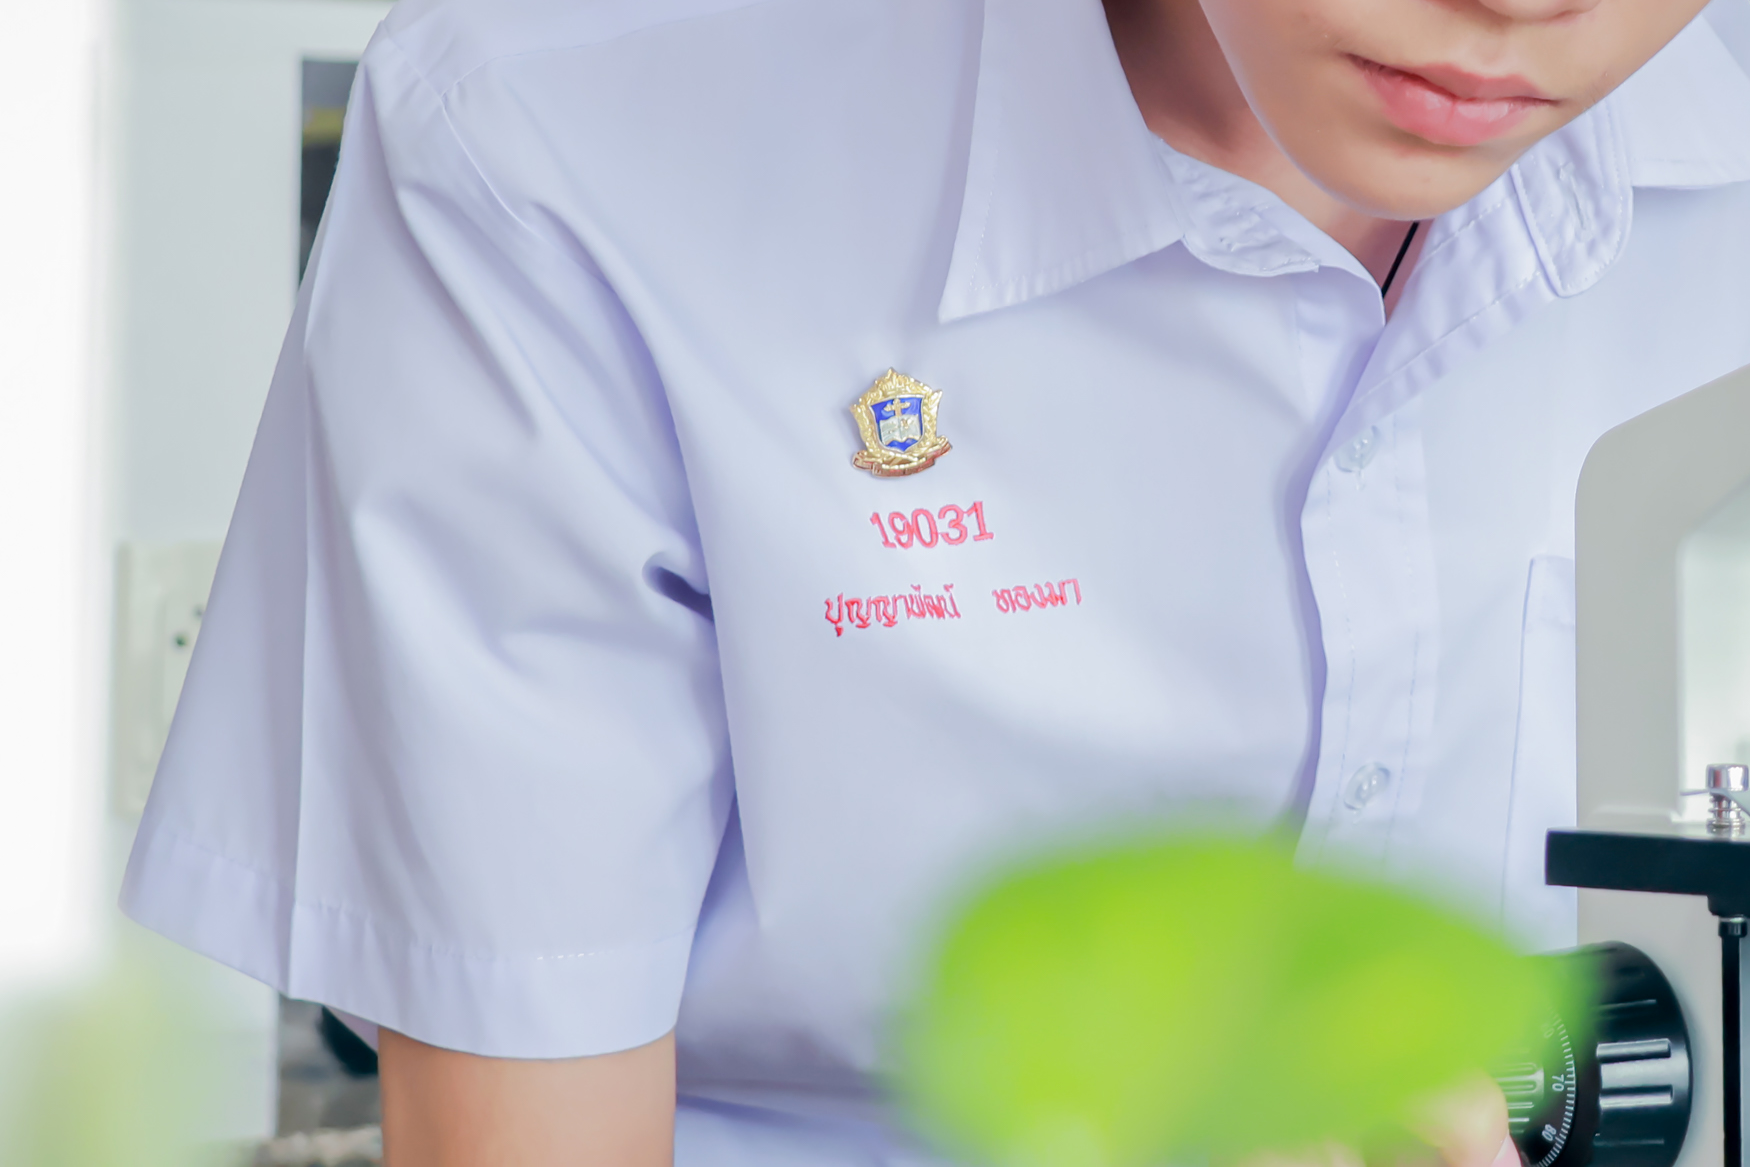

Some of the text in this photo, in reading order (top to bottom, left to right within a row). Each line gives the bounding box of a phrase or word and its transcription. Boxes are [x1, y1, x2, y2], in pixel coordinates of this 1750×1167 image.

[870, 500, 994, 549] 19031
[991, 578, 1083, 614] ทองมา
[1551, 1073, 1565, 1092] 70
[1541, 1123, 1558, 1142] 80
